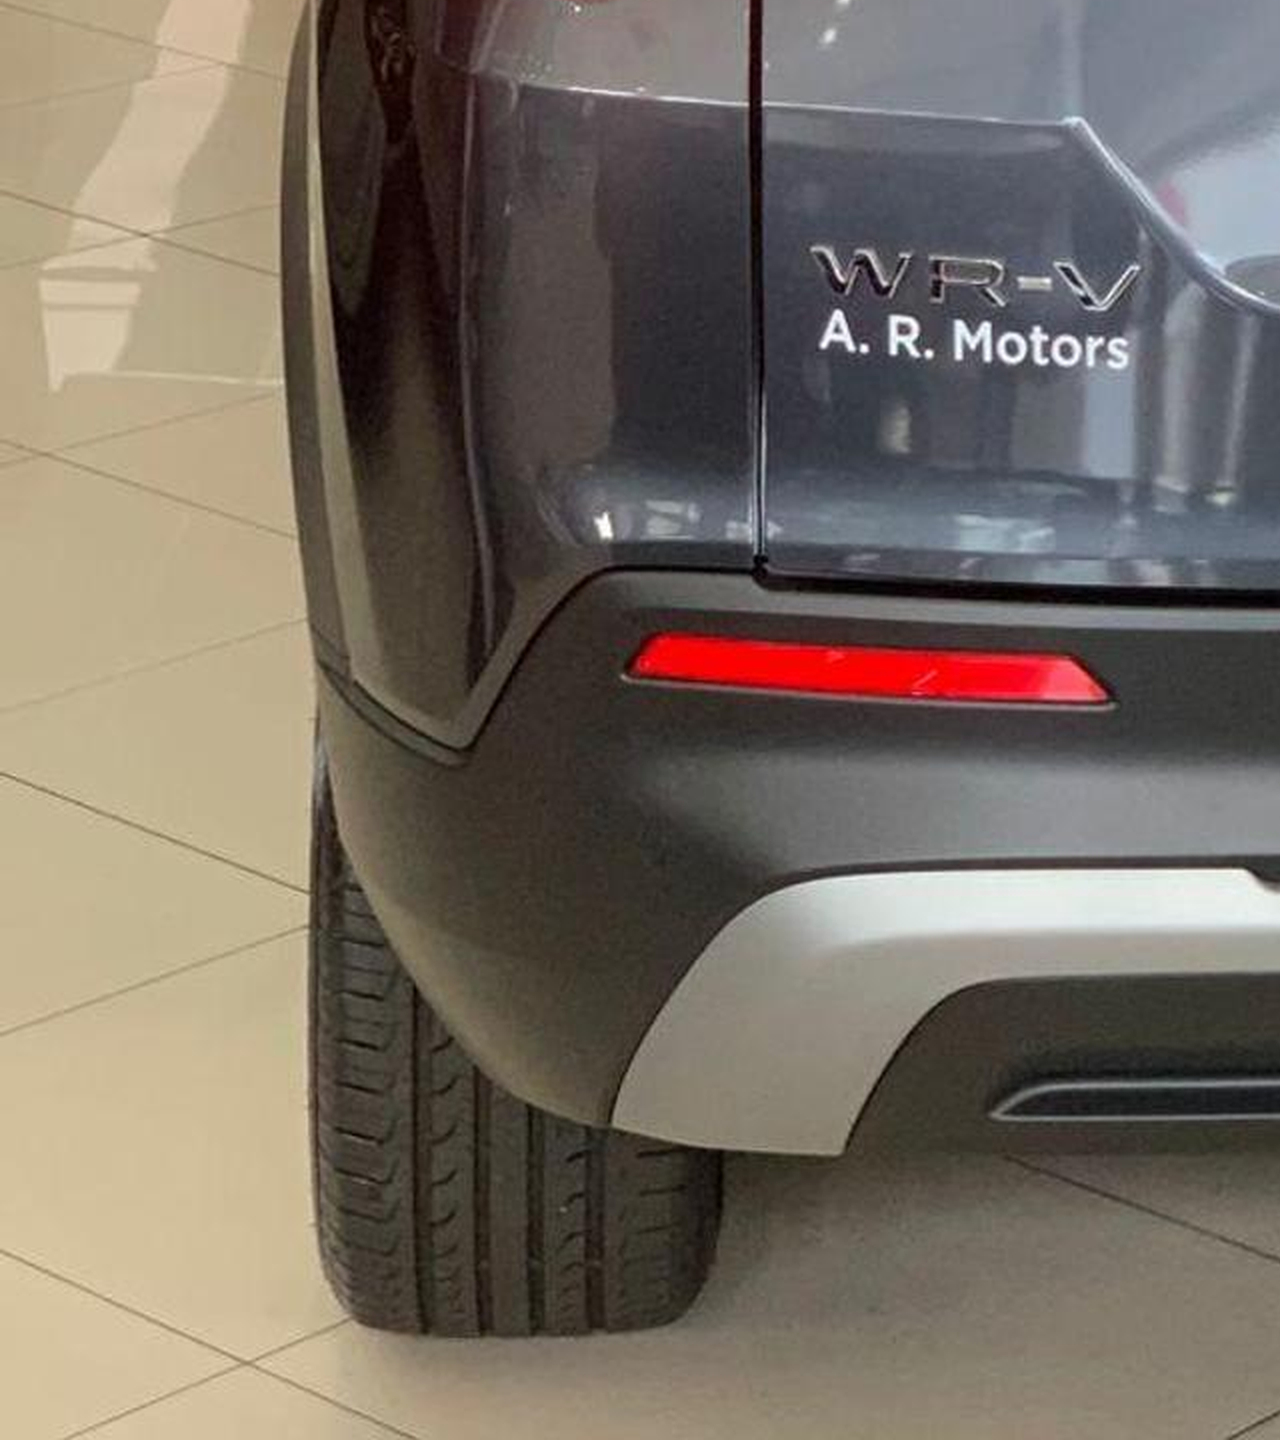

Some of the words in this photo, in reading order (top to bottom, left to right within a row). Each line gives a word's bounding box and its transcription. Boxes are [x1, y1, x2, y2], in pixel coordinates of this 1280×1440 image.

[810, 245, 1142, 312] WR-V
[818, 307, 871, 355] A.
[887, 314, 935, 361] R.
[952, 319, 1132, 369] Motors
